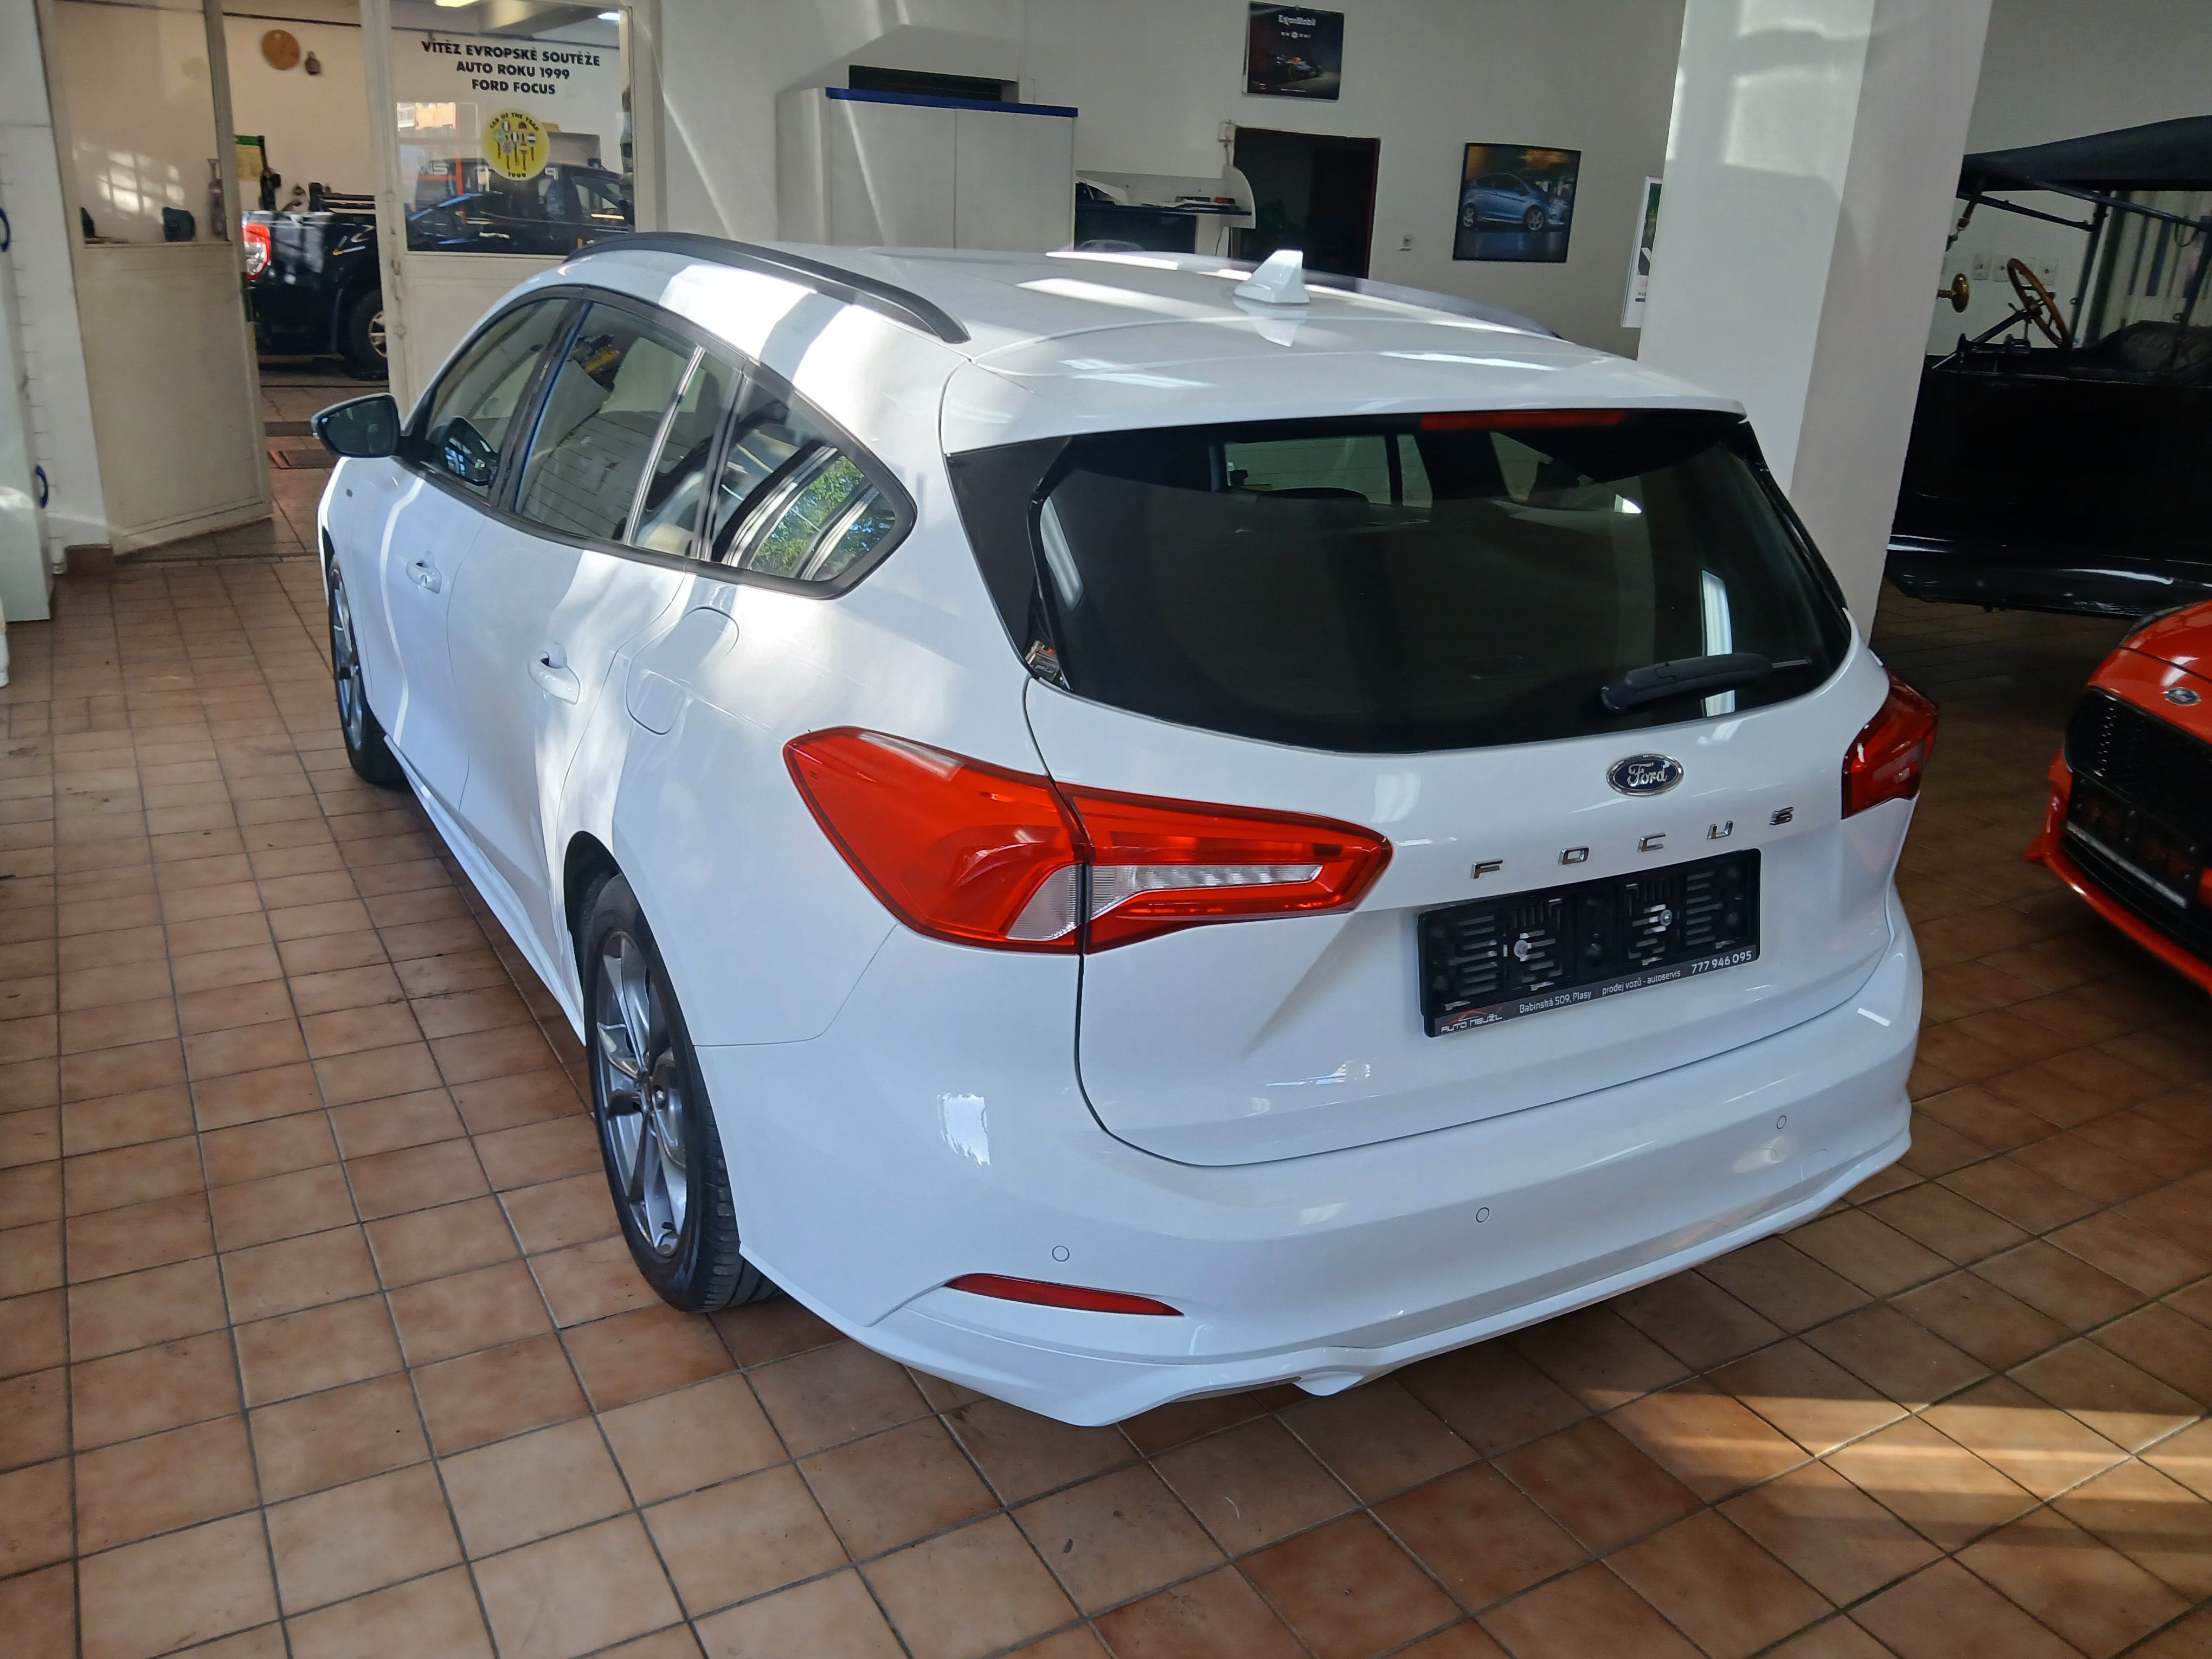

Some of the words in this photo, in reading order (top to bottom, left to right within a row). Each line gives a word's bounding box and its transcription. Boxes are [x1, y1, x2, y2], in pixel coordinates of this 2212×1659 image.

[466, 44, 538, 61] EVROPSKÉ
[542, 50, 600, 66] SOUTĚŽE
[456, 60, 493, 74] AUTO
[497, 63, 536, 77] ROKU
[541, 67, 570, 80] 1999
[472, 78, 509, 92] FORD
[513, 81, 556, 95] FOCUS
[1627, 762, 1668, 787] Ford
[1470, 806, 1795, 879] FOCUS
[1691, 960, 1710, 974] 777
[1711, 955, 1731, 969] 946
[1732, 950, 1752, 964] 095
[1602, 981, 1624, 996] prodej
[1625, 977, 1642, 990] vozů
[1647, 969, 1681, 984] autoservis
[1519, 999, 1553, 1014] Babinská
[1573, 991, 1592, 1002] Plasy
[1441, 1021, 1467, 1033] AUTO
